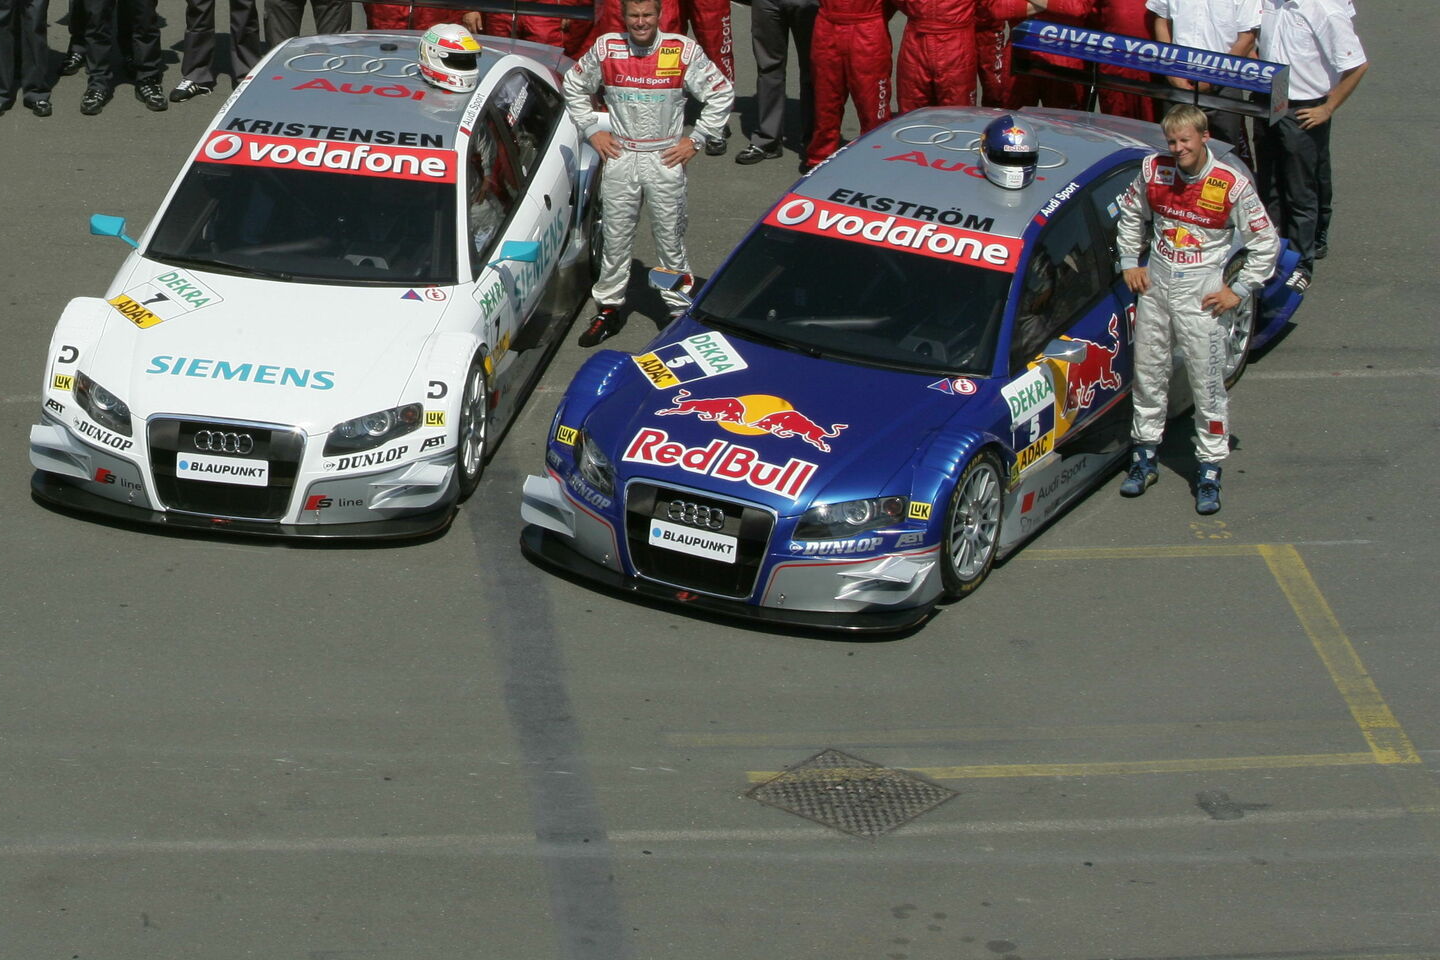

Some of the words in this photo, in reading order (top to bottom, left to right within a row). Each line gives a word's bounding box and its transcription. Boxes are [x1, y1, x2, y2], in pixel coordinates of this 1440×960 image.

[720, 16, 732, 54] Sport
[660, 47, 681, 56] ADAC
[1038, 24, 1117, 53] GIVES
[1121, 37, 1181, 67] YOU
[1186, 48, 1276, 85] WINGS
[291, 76, 426, 102] Audi
[625, 75, 645, 84] Audi
[645, 77, 671, 85] Sport
[464, 109, 477, 128] Audi
[471, 92, 486, 114] Sport
[877, 78, 887, 120] Sport
[225, 116, 444, 149] KRISTENSEN
[248, 140, 448, 179] vodafone
[1206, 177, 1227, 190] ADAC
[827, 186, 995, 232] EKSTRÖM
[1041, 196, 1060, 218] Audi
[1058, 181, 1081, 203] Sport
[1167, 207, 1186, 218] Audi
[1186, 211, 1210, 224] Sport
[816, 209, 1010, 267] vodafone
[1156, 240, 1174, 262] Red
[1176, 249, 1203, 264] Bull
[140, 292, 170, 306] 7
[157, 271, 211, 308] DEKRA
[480, 276, 507, 320] DEKRA
[115, 299, 154, 325] ADAC
[665, 353, 695, 370] 5
[688, 334, 736, 375] DEKRA
[146, 355, 335, 390] SIEMENS
[639, 358, 675, 384] ADAC
[45, 398, 66, 414] ABT
[1010, 373, 1054, 419] DEKRA
[78, 420, 134, 451] DUNLOP
[1029, 416, 1040, 442] 5
[419, 434, 448, 452] ABT
[1020, 435, 1048, 470] ADAC
[190, 461, 266, 478] BLAUPUNKT
[336, 445, 409, 471] DUNLOP
[622, 427, 725, 474] Red
[712, 442, 818, 500] Bull
[120, 477, 142, 491] line
[1037, 479, 1059, 502] Audi
[1060, 455, 1088, 485] Sport
[338, 496, 364, 508] line
[662, 530, 734, 555] BLAUPUNKT
[802, 537, 883, 556] DUNLOP
